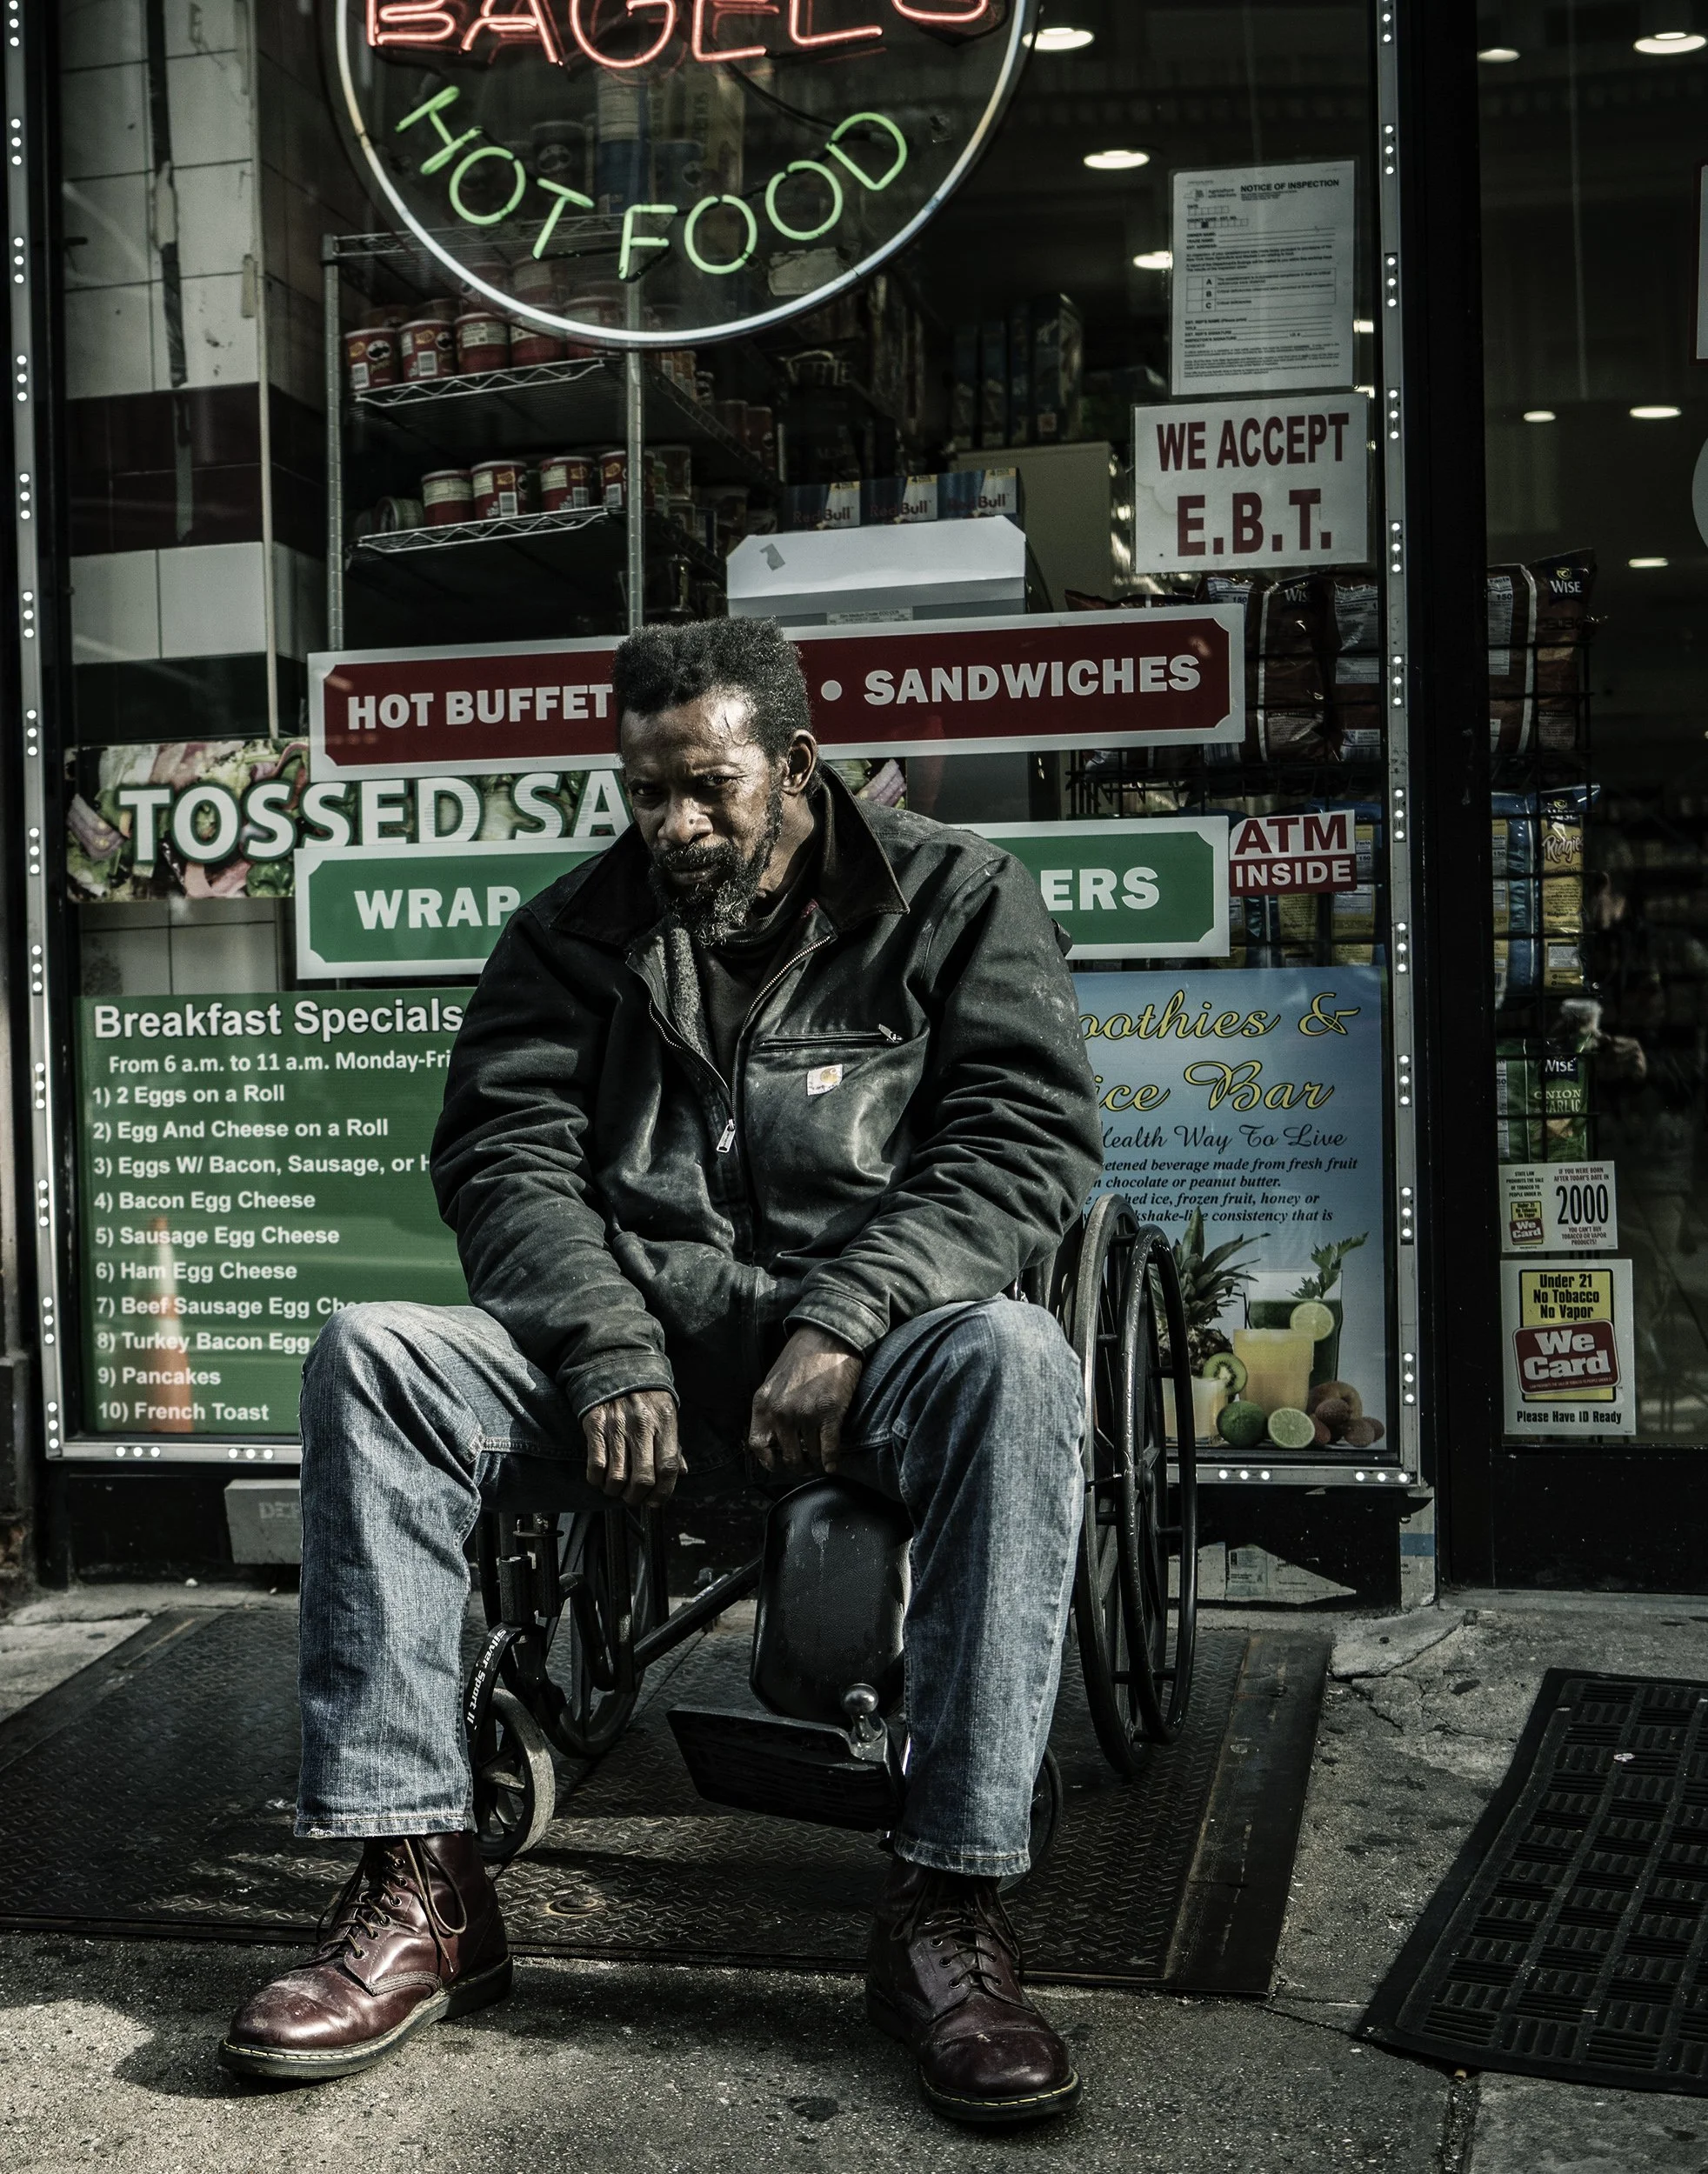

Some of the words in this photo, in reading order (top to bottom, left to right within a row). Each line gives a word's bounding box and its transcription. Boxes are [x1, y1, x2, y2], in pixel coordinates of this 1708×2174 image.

[365, 0, 987, 68] BAGEL
[395, 86, 593, 259] HOT
[618, 112, 907, 280] FOOD
[1240, 183, 1271, 193] NOTICE
[1274, 183, 1286, 191] OF
[1287, 179, 1339, 190] INSPECTION
[1156, 422, 1206, 471] WE
[1217, 412, 1350, 469] ACCEPT
[870, 503, 898, 517] Red
[901, 501, 928, 515] Bull
[977, 494, 1006, 509] Bull
[824, 507, 851, 522] Bull
[1177, 488, 1331, 557] E.B.T.
[1549, 579, 1583, 595] WISE
[864, 654, 1201, 706] SANDWICHES
[348, 693, 433, 730] HOT
[446, 684, 613, 725] BUFFET
[117, 774, 484, 864] TOSSED
[1234, 814, 1348, 855] ATM
[1236, 859, 1352, 888] INSIDE
[93, 1003, 283, 1040] Breakfast
[293, 998, 464, 1043] Specials
[1298, 992, 1361, 1037] &
[109, 1055, 159, 1074] From
[163, 1054, 177, 1073] 6
[181, 1057, 224, 1073] a.m.
[230, 1054, 251, 1072] to
[257, 1053, 281, 1071] 11
[285, 1054, 330, 1070] a.m.
[92, 1088, 110, 1108] 1)
[117, 1087, 129, 1104] 2
[135, 1087, 187, 1108] Eggs
[193, 1089, 218, 1103] on
[225, 1090, 237, 1103] a
[244, 1084, 285, 1102] Roll
[1184, 1060, 1335, 1112] Bar
[1533, 1089, 1582, 1100] ONION
[1545, 1099, 1581, 1113] ARLIC
[93, 1123, 112, 1143] 2)
[117, 1122, 158, 1143] Egg
[163, 1121, 205, 1138] And
[210, 1120, 289, 1138] Cheese
[295, 1123, 321, 1137] on
[328, 1124, 340, 1137] a
[346, 1118, 389, 1136] Roll
[1174, 1124, 1232, 1155] Way
[1238, 1124, 1280, 1149] To
[1283, 1123, 1348, 1148] Live
[93, 1157, 113, 1178] 3)
[118, 1157, 170, 1178] Eggs
[177, 1155, 204, 1174] W/
[210, 1156, 282, 1177] Bacon,
[288, 1155, 385, 1177] Sausage,
[391, 1158, 415, 1172] or
[1104, 1157, 1147, 1171] etened
[1151, 1158, 1209, 1174] beverage
[1212, 1157, 1248, 1171] made
[1250, 1157, 1284, 1173] from
[1286, 1157, 1324, 1173] fresh
[1322, 1157, 1358, 1173] fruit
[1105, 1175, 1169, 1189] chocolate
[1172, 1177, 1187, 1189] or
[1188, 1176, 1237, 1190] peanut
[1239, 1174, 1281, 1188] butter.
[94, 1191, 113, 1213] 4)
[119, 1191, 184, 1210] Bacon
[190, 1190, 232, 1212] Egg
[237, 1190, 316, 1209] Cheese
[1151, 1192, 1173, 1206] ice,
[1174, 1192, 1219, 1208] frozen
[1219, 1191, 1257, 1208] fruit,
[1259, 1191, 1301, 1207] honey
[1304, 1194, 1319, 1205] or
[1556, 1184, 1609, 1225] 2000
[1135, 1209, 1208, 1222] kshake-lie
[1211, 1208, 1288, 1224] consistency
[1291, 1208, 1318, 1222] that
[1320, 1208, 1334, 1222] is
[1515, 1220, 1537, 1230] We
[96, 1227, 114, 1248] 5)
[120, 1226, 208, 1248] Sausage
[215, 1227, 255, 1248] Egg
[261, 1226, 340, 1244] Cheese
[1511, 1227, 1542, 1239] Card
[96, 1263, 114, 1283] 6)
[121, 1262, 167, 1280] Ham
[174, 1262, 213, 1283] Egg
[219, 1261, 297, 1279] Cheese
[1539, 1274, 1575, 1288] Under
[1578, 1273, 1592, 1288] 21
[1533, 1290, 1548, 1304] No
[1551, 1289, 1600, 1303] Tobacco
[97, 1298, 115, 1318] 7)
[122, 1297, 169, 1315] Beef
[174, 1297, 262, 1318] Sausage
[269, 1297, 310, 1319] Egg
[1540, 1304, 1555, 1318] No
[1558, 1304, 1594, 1320] Vapor
[97, 1333, 115, 1354] 8)
[122, 1332, 189, 1353] Turkey
[196, 1332, 263, 1350] Bacon
[270, 1332, 310, 1354] Egg
[1534, 1329, 1596, 1356] We
[1523, 1349, 1611, 1381] Card
[98, 1369, 117, 1388] 9)
[122, 1367, 221, 1385] Pancakes
[98, 1403, 129, 1423] 10)
[135, 1401, 205, 1420] French
[211, 1402, 269, 1420] Toast
[1516, 1410, 1549, 1423] Please
[1552, 1410, 1576, 1423] Have
[1578, 1410, 1590, 1423] ID
[1592, 1410, 1622, 1424] Ready
[483, 1628, 507, 1669] Silver
[470, 1670, 486, 1710] Sport
